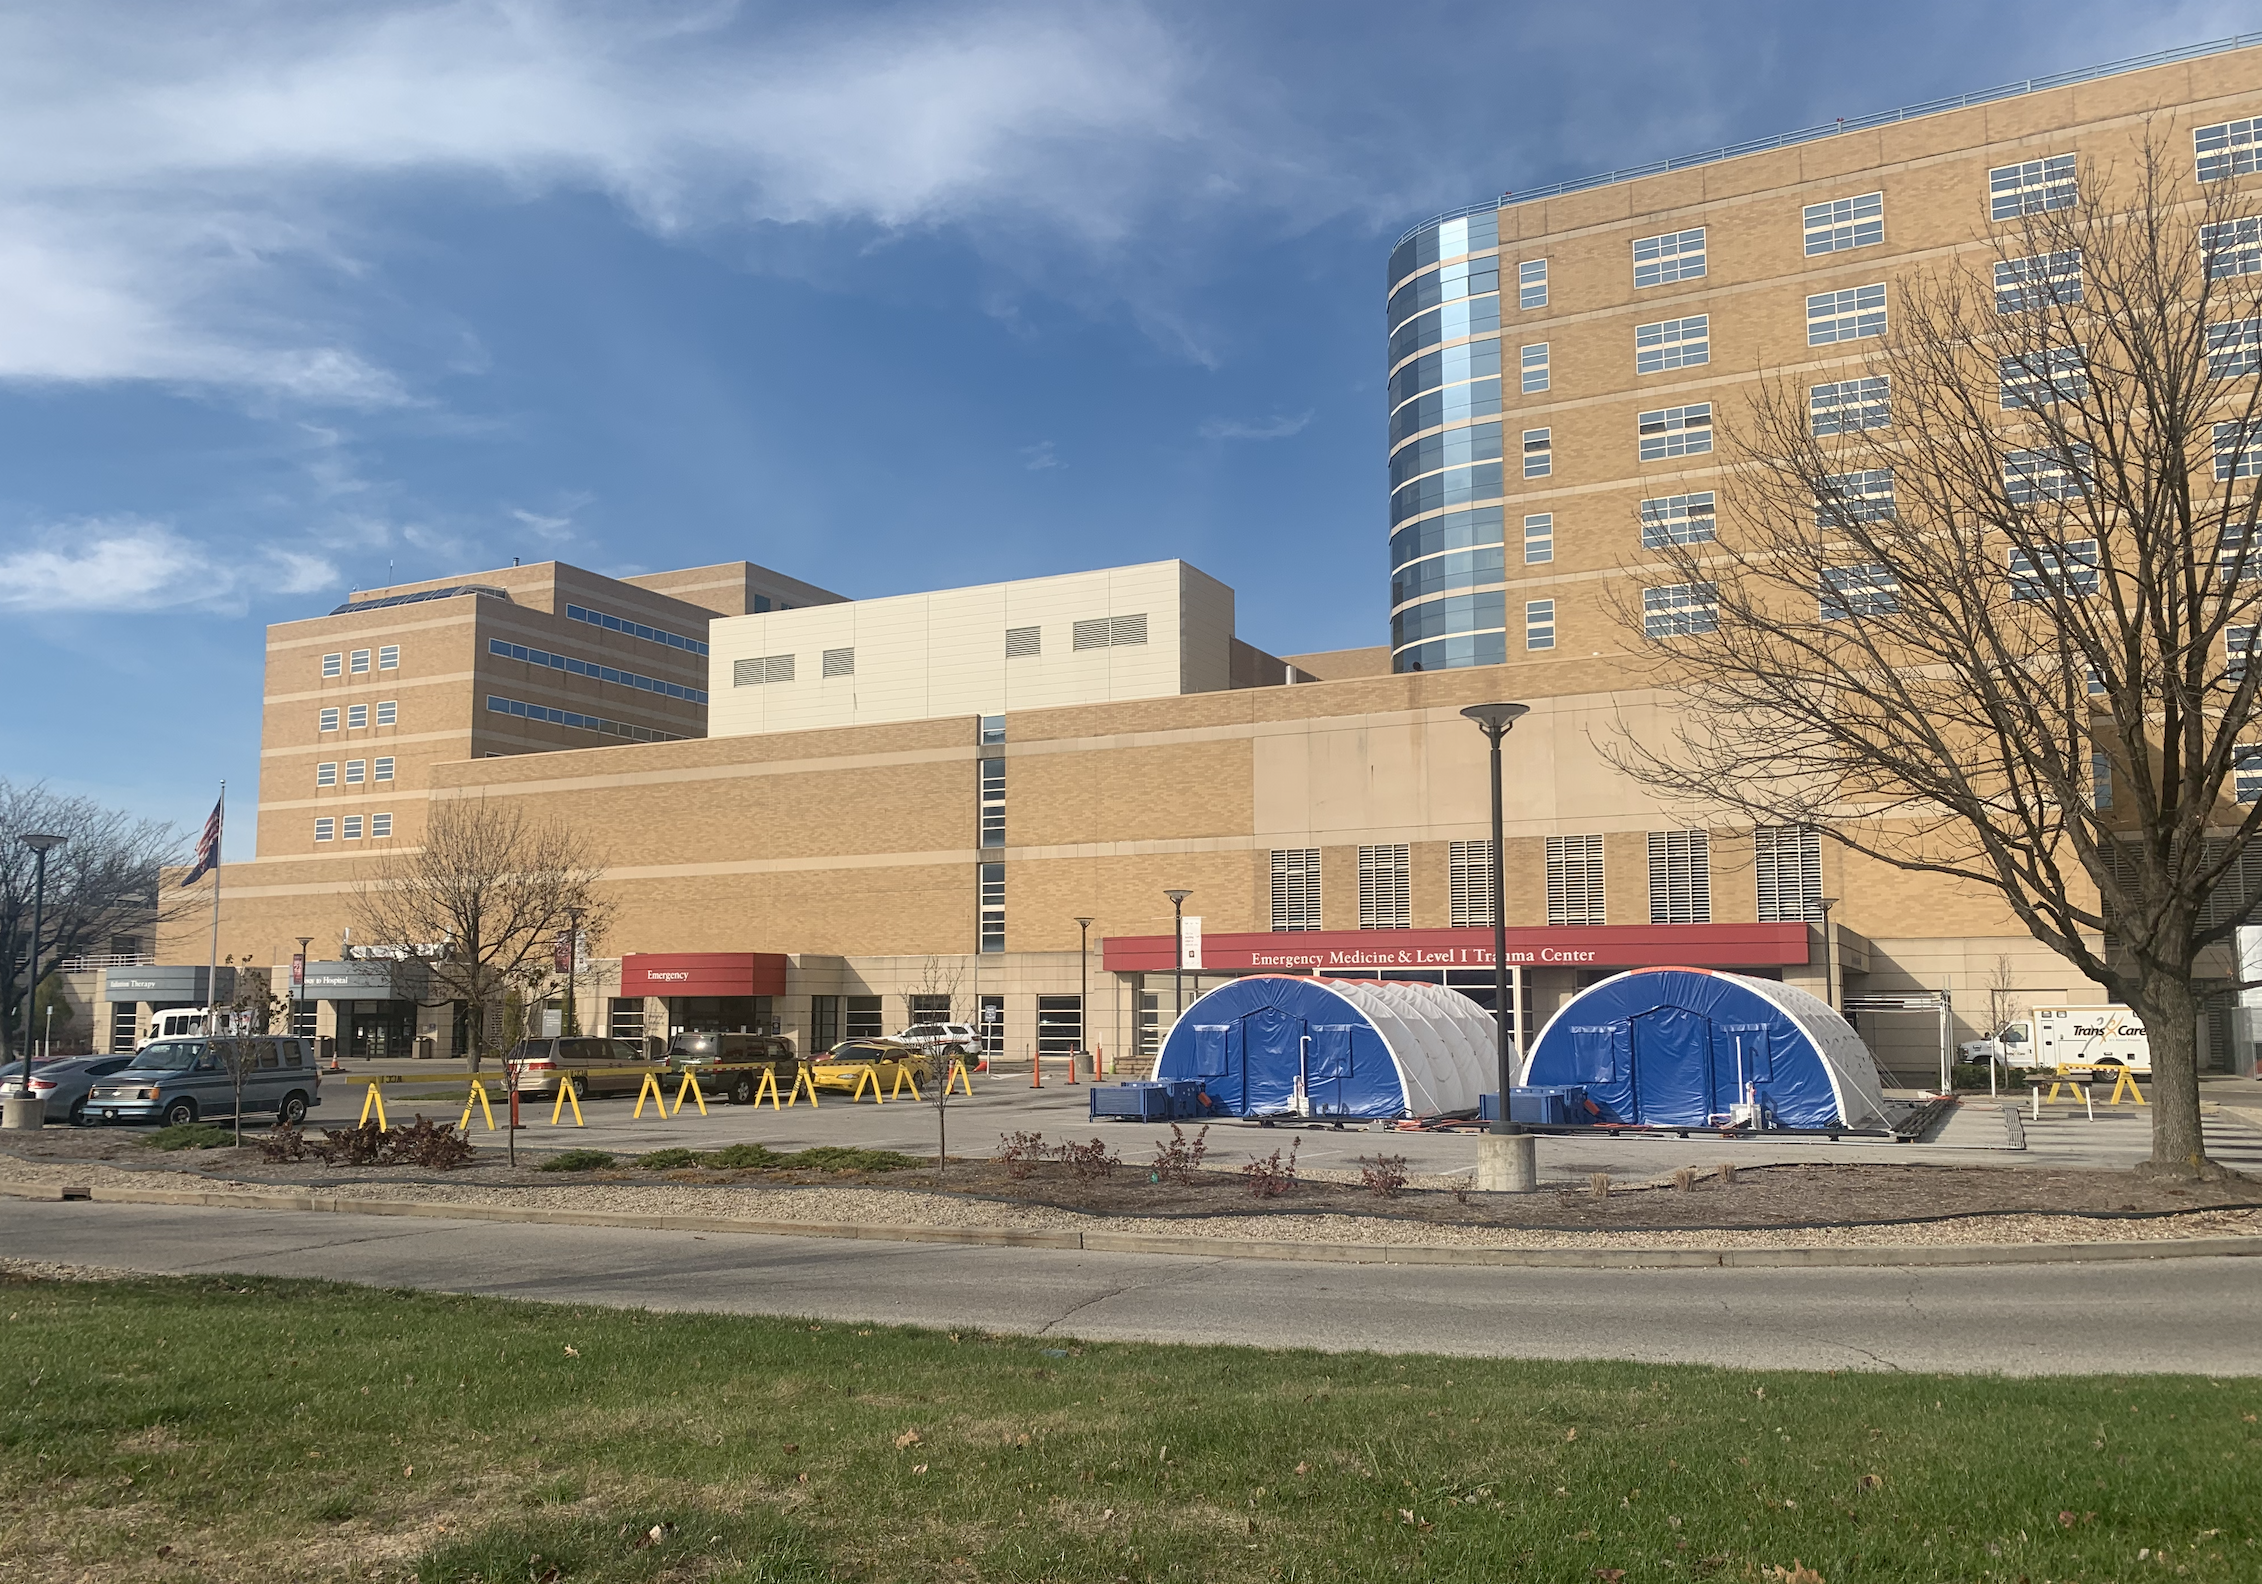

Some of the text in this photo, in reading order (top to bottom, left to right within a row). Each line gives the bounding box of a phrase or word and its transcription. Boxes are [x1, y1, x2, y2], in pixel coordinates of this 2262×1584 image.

[1252, 953, 1323, 967] Emergency
[1329, 950, 1395, 965] Medicine
[1398, 950, 1412, 963] &
[1416, 949, 1454, 963] Level
[1541, 947, 1595, 962] Center
[323, 976, 348, 986] Hospital
[647, 970, 689, 981] Emergency
[131, 980, 156, 989] Therapy
[2073, 1025, 2146, 1036] Trans Care
